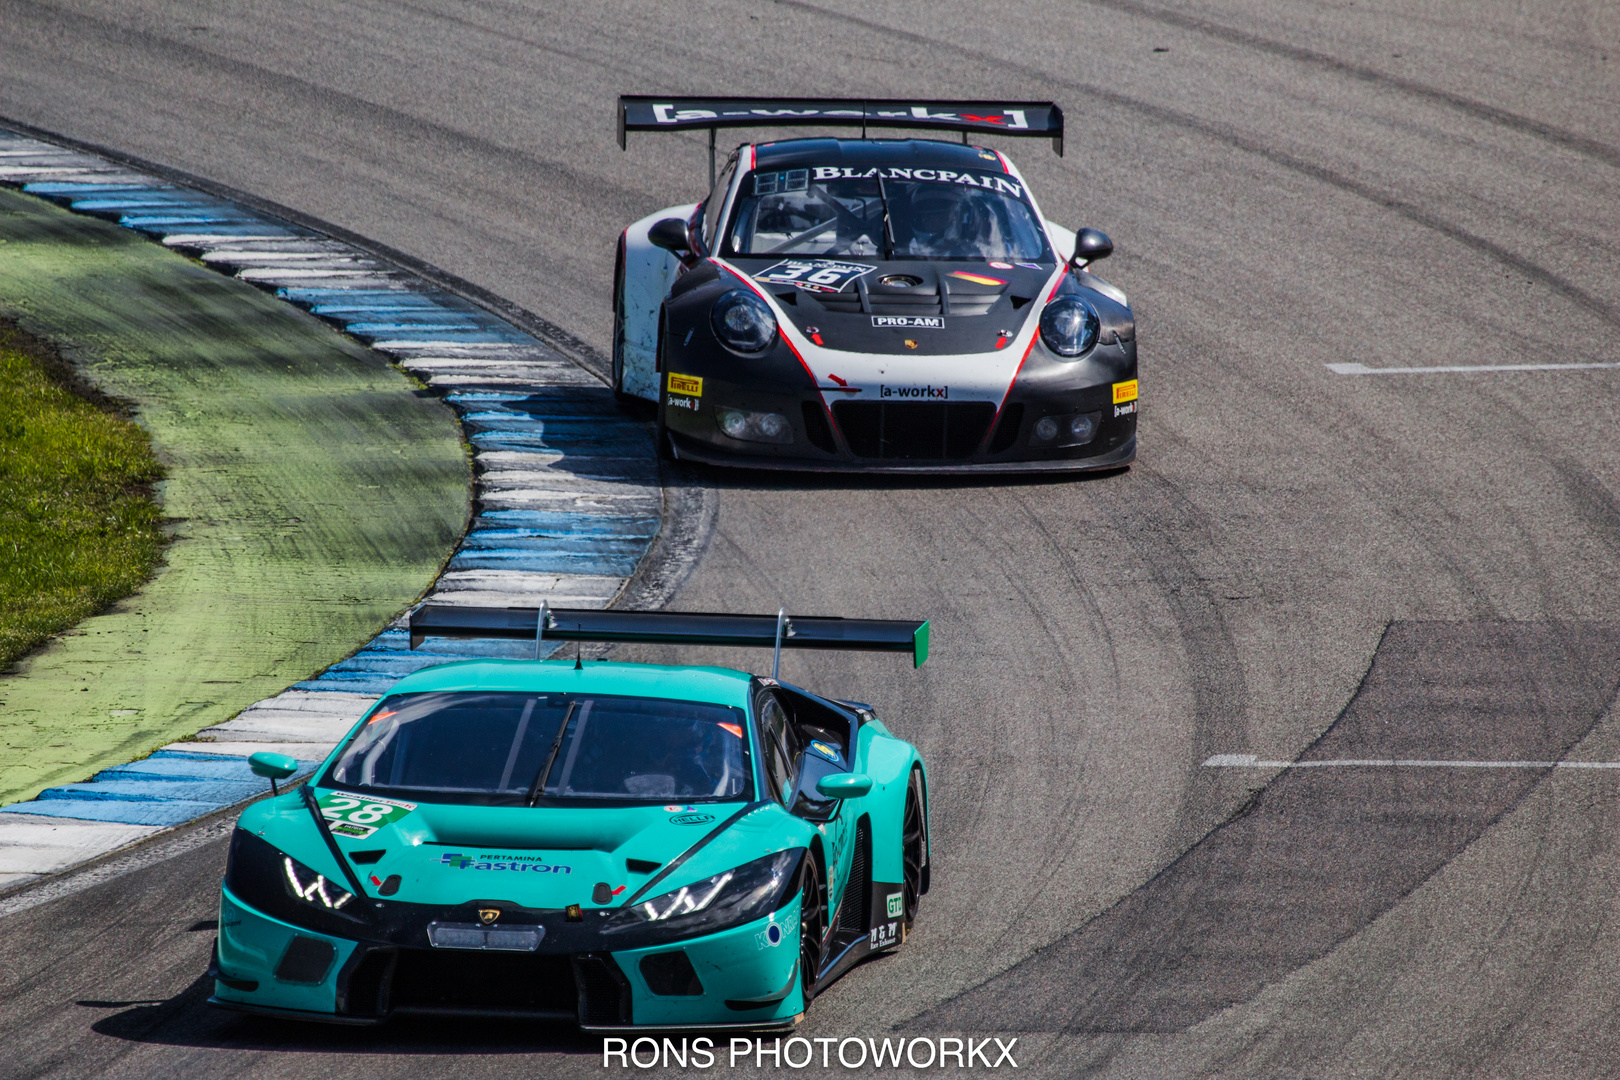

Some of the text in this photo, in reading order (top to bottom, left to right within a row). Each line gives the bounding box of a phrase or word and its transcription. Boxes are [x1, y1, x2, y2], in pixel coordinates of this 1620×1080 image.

[812, 166, 1022, 198] BLANCPAIN
[769, 265, 851, 284] 36
[877, 317, 940, 327] PRO-AM
[670, 376, 699, 392] PIRELLI
[320, 798, 394, 824] 28
[480, 854, 543, 862] PERTAMINA
[459, 859, 572, 875] Fastron
